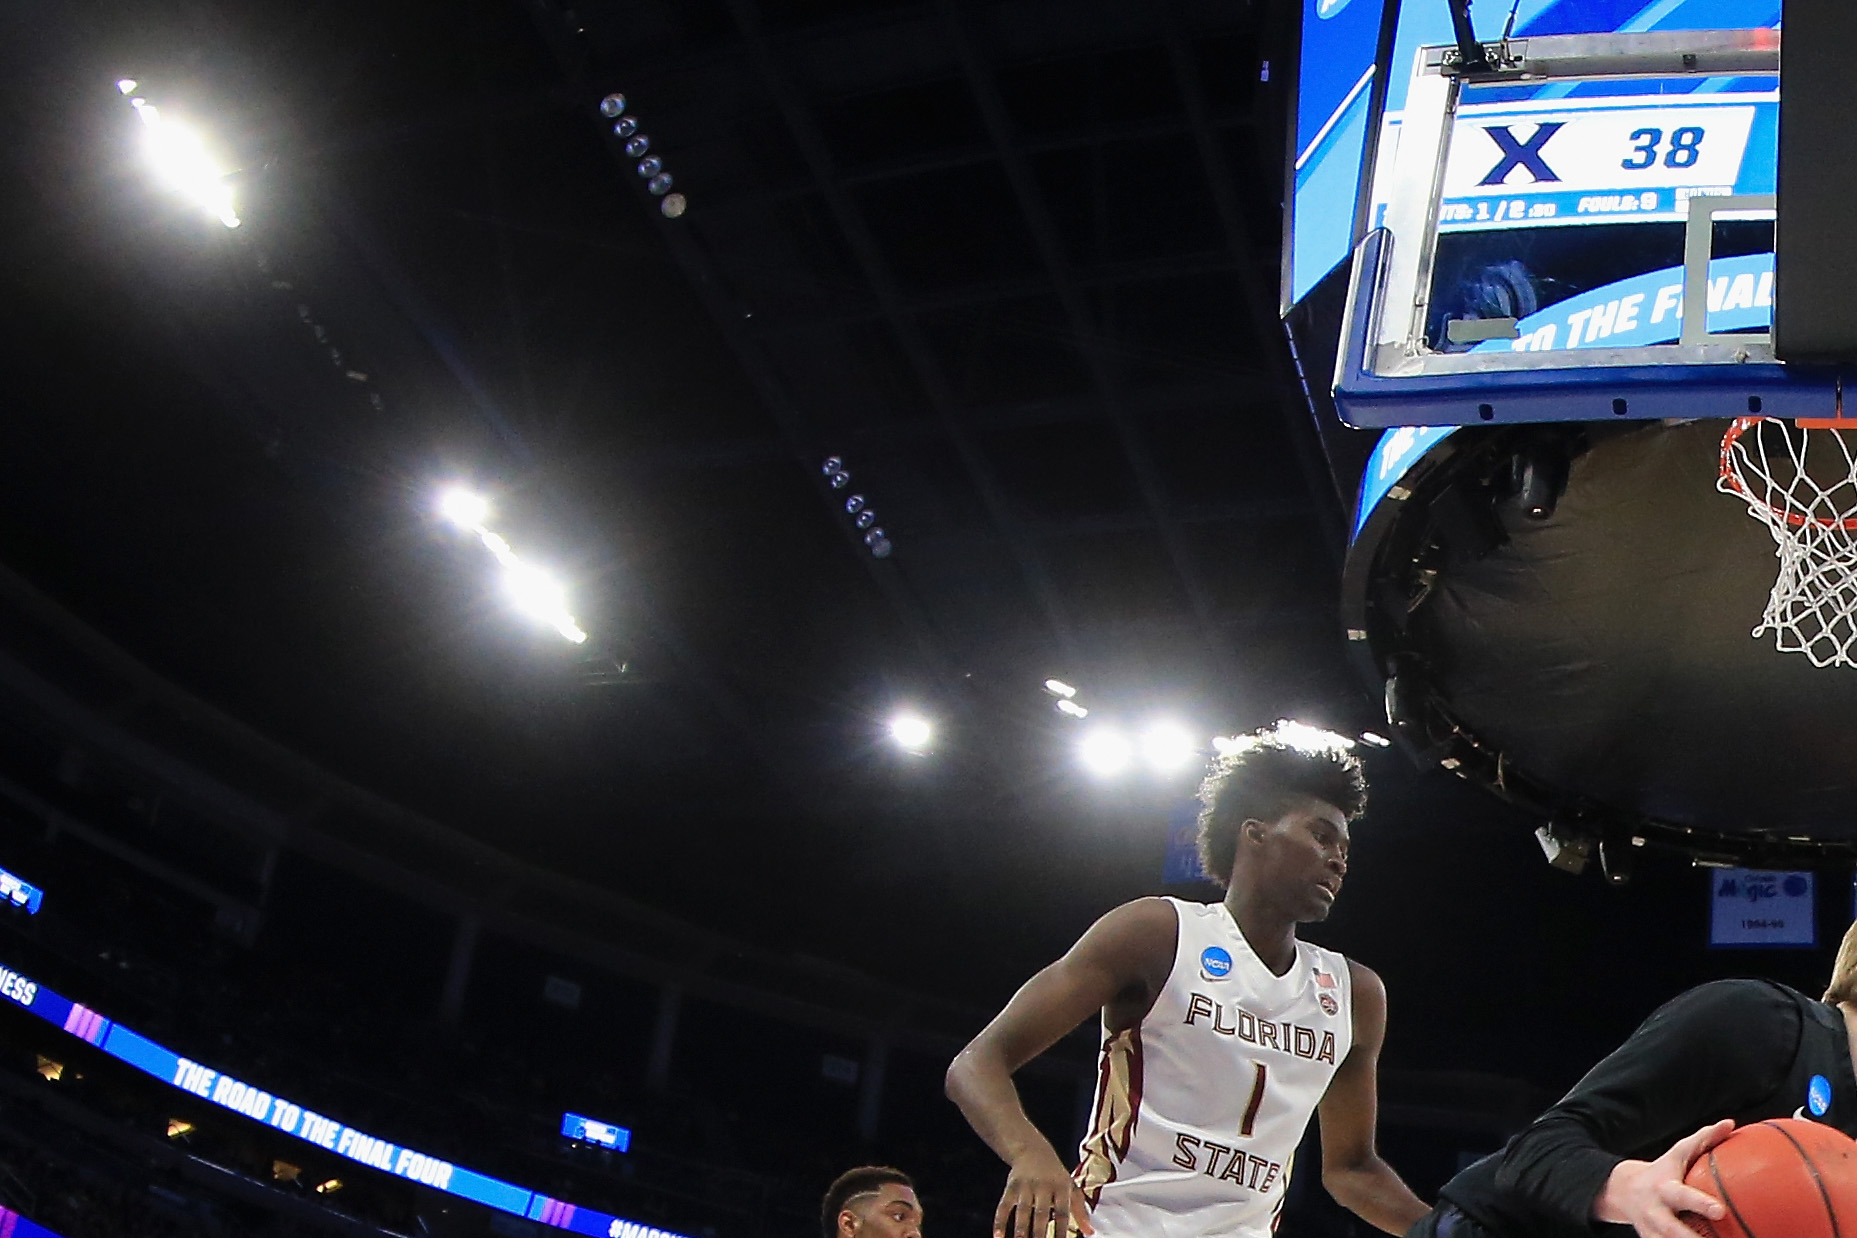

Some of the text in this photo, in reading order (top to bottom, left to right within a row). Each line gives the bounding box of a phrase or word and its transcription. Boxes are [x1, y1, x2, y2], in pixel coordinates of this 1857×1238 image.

[1474, 121, 1568, 187] X
[1621, 126, 1705, 170] 38
[1476, 202, 1490, 220] 1
[1566, 288, 1647, 349] THE
[1183, 992, 1336, 1066] FLORIDA
[173, 1057, 453, 1190] THE ROAD TO THE FINAL FOUR
[1238, 1061, 1266, 1139] 1
[1172, 1132, 1282, 1194] STATE
